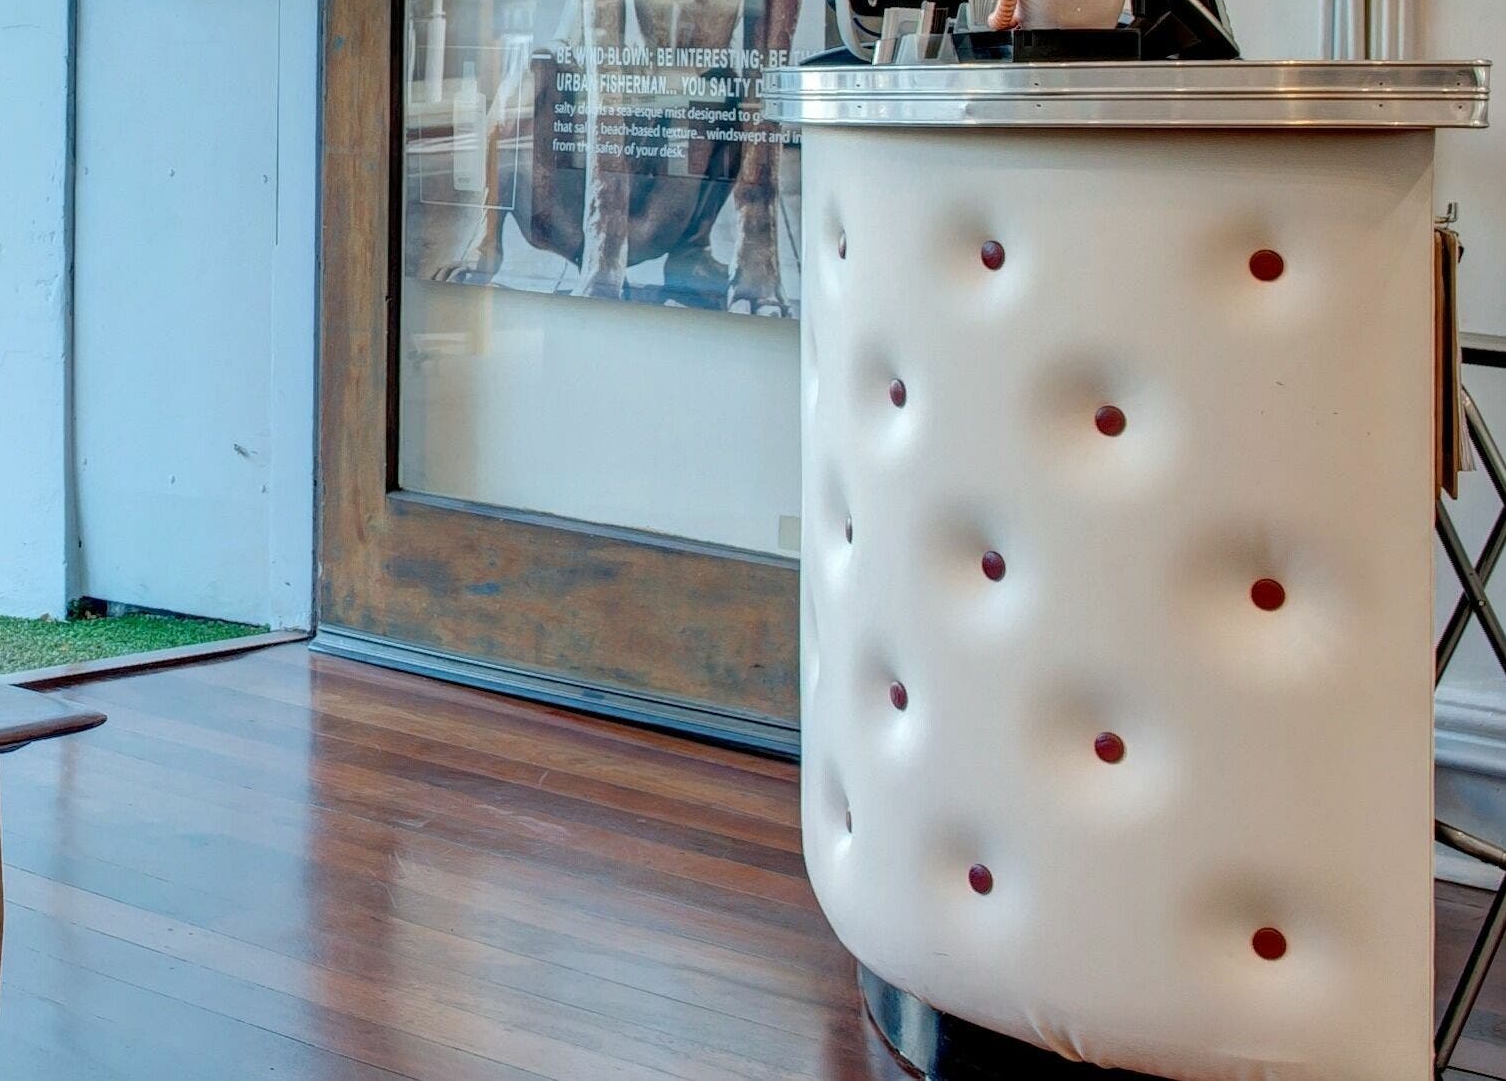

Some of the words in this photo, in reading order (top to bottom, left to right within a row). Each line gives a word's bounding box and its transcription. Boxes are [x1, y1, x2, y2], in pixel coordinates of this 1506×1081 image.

[556, 46, 572, 64] BE
[657, 47, 673, 66] BE
[769, 49, 788, 68] BE
[556, 72, 597, 91] URBA
[681, 76, 706, 96] YOU
[709, 77, 751, 98] SALTY
[665, 105, 687, 119] mist
[688, 107, 736, 123] designed
[738, 109, 750, 122] to
[553, 120, 573, 133] that
[706, 127, 767, 145] windswept
[768, 130, 789, 144] and
[553, 138, 575, 152] from
[624, 143, 636, 155] of
[636, 145, 658, 159] your
